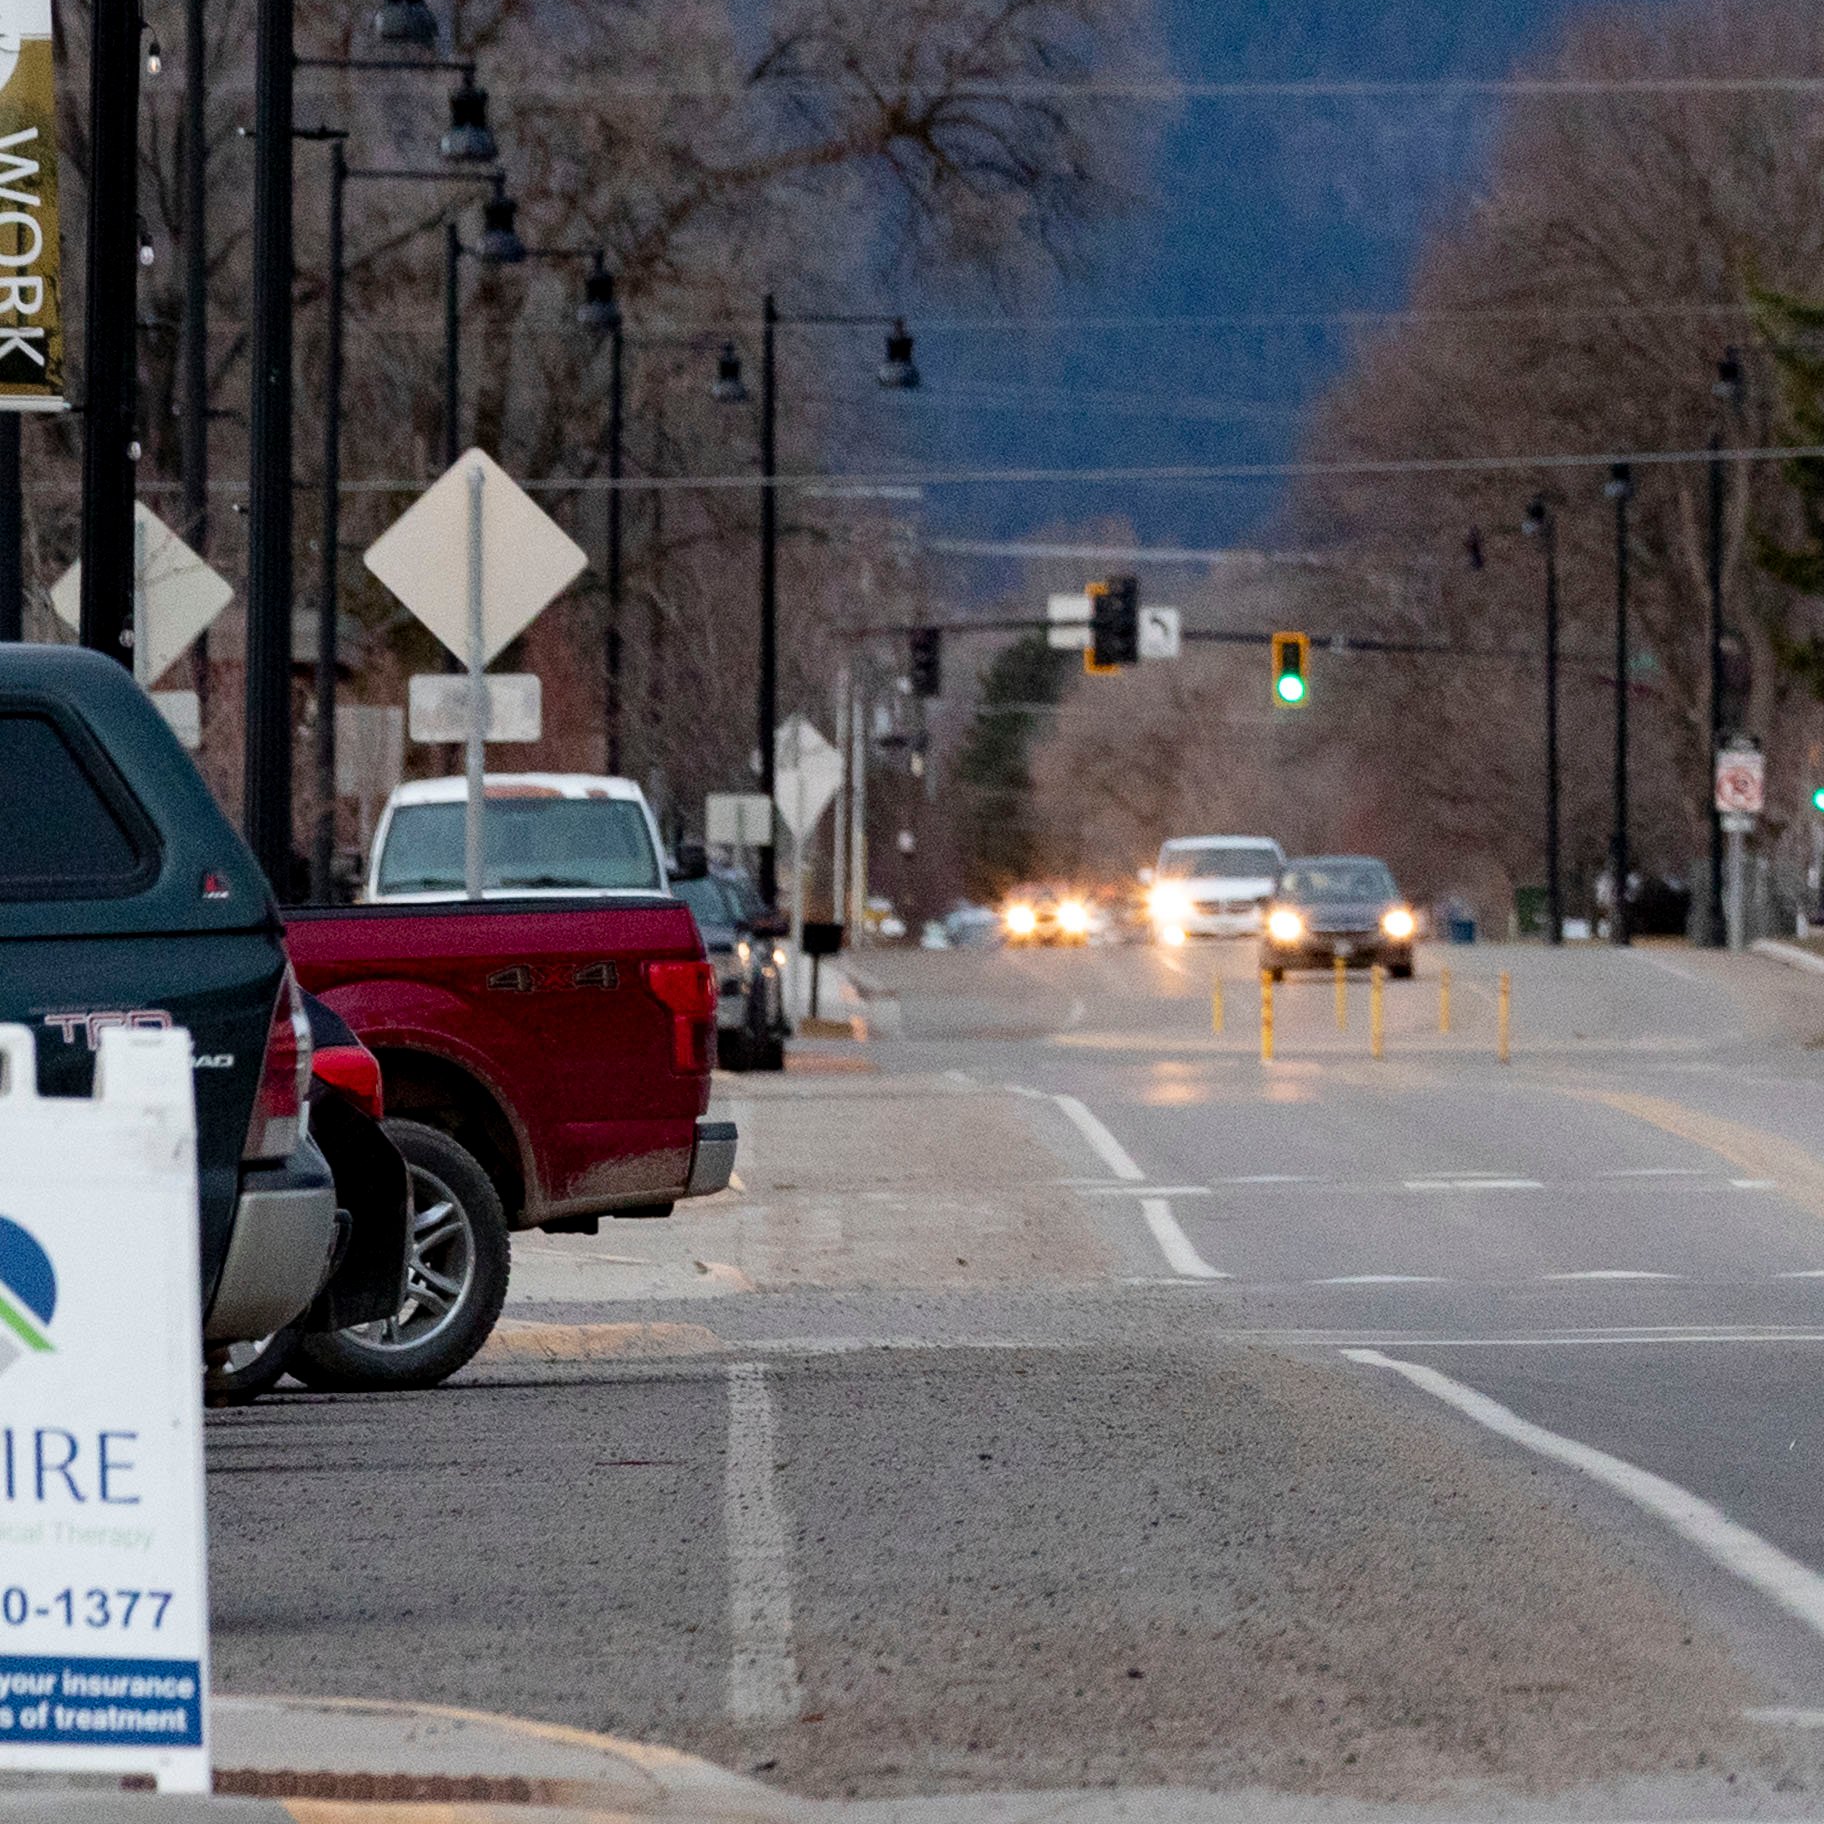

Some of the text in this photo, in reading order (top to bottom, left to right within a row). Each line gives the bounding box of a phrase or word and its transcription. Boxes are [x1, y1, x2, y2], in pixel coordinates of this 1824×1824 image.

[5, 1428, 142, 1503] IRE
[3, 1588, 173, 1628] 0-1377
[0, 1668, 195, 1701] your insurance
[19, 1701, 49, 1729] of
[54, 1704, 188, 1732] treatment
